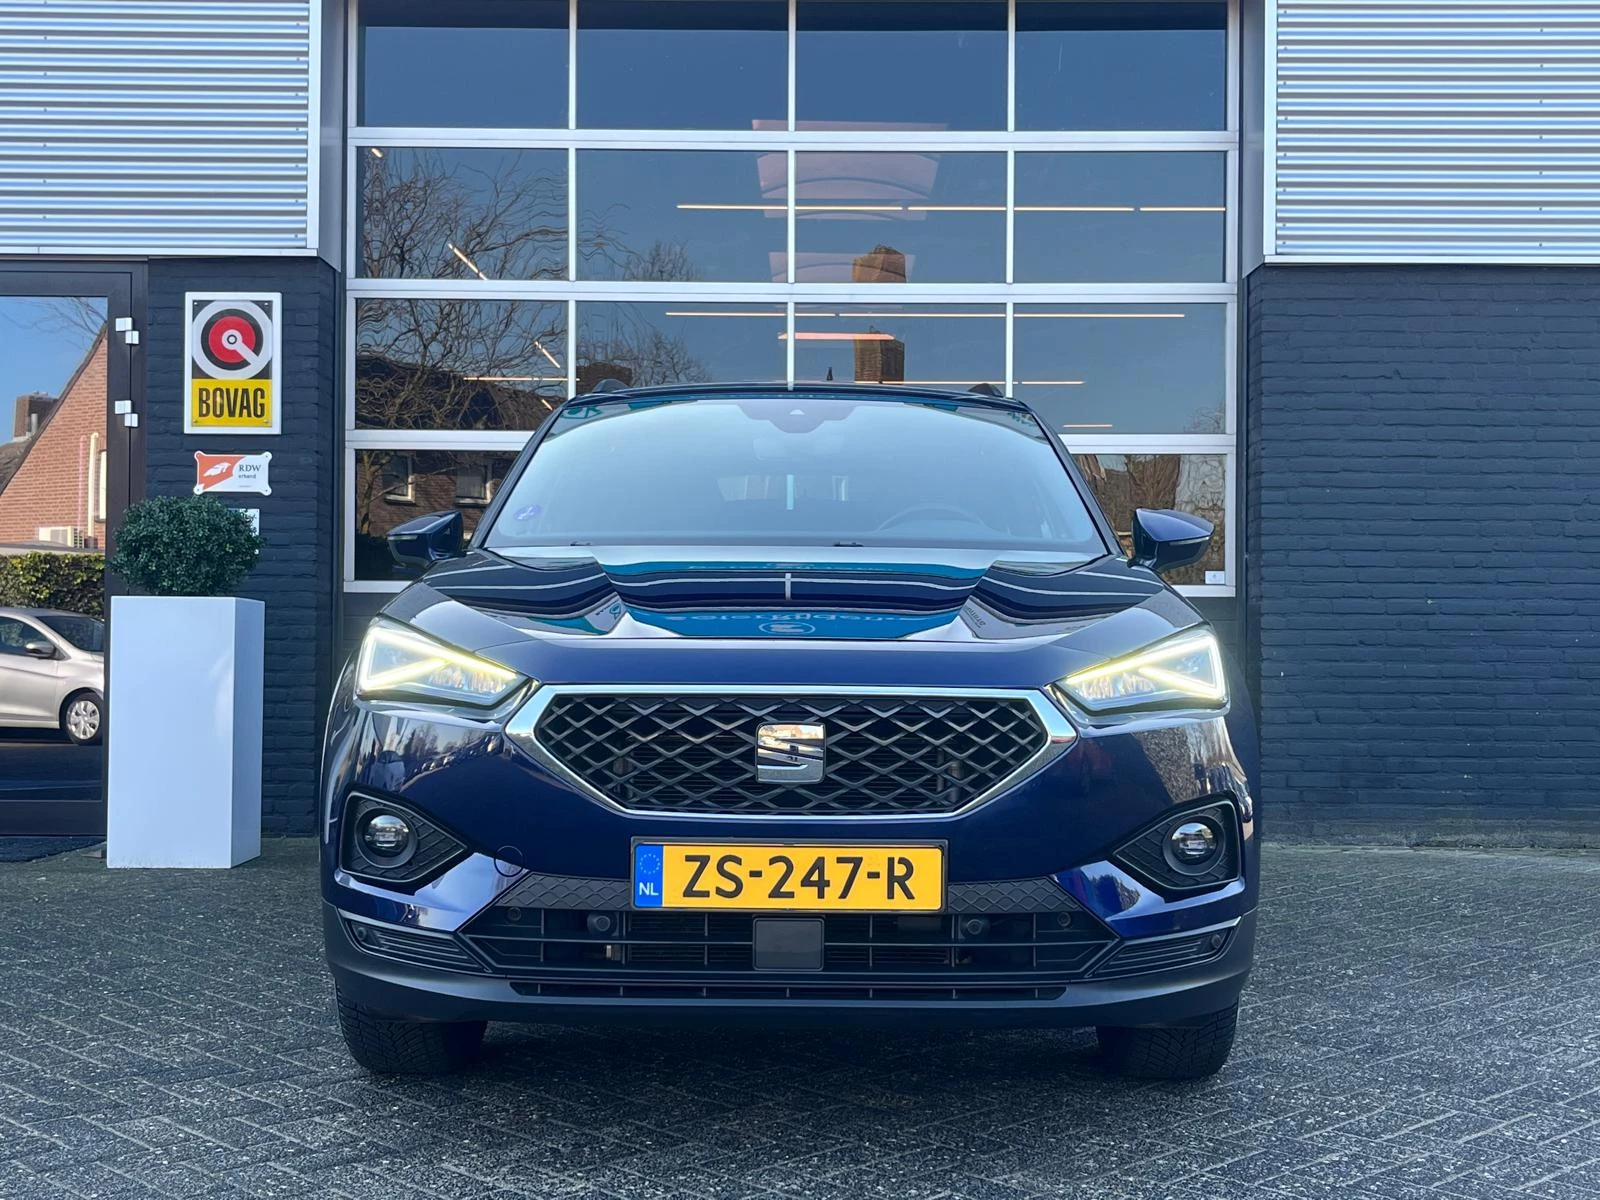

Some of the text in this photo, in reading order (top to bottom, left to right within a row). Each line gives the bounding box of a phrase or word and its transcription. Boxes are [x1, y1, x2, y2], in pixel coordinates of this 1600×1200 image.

[198, 388, 265, 418] BOVAG
[239, 464, 262, 472] RDW
[682, 854, 916, 901] ZS-247-R
[639, 882, 659, 896] NL
